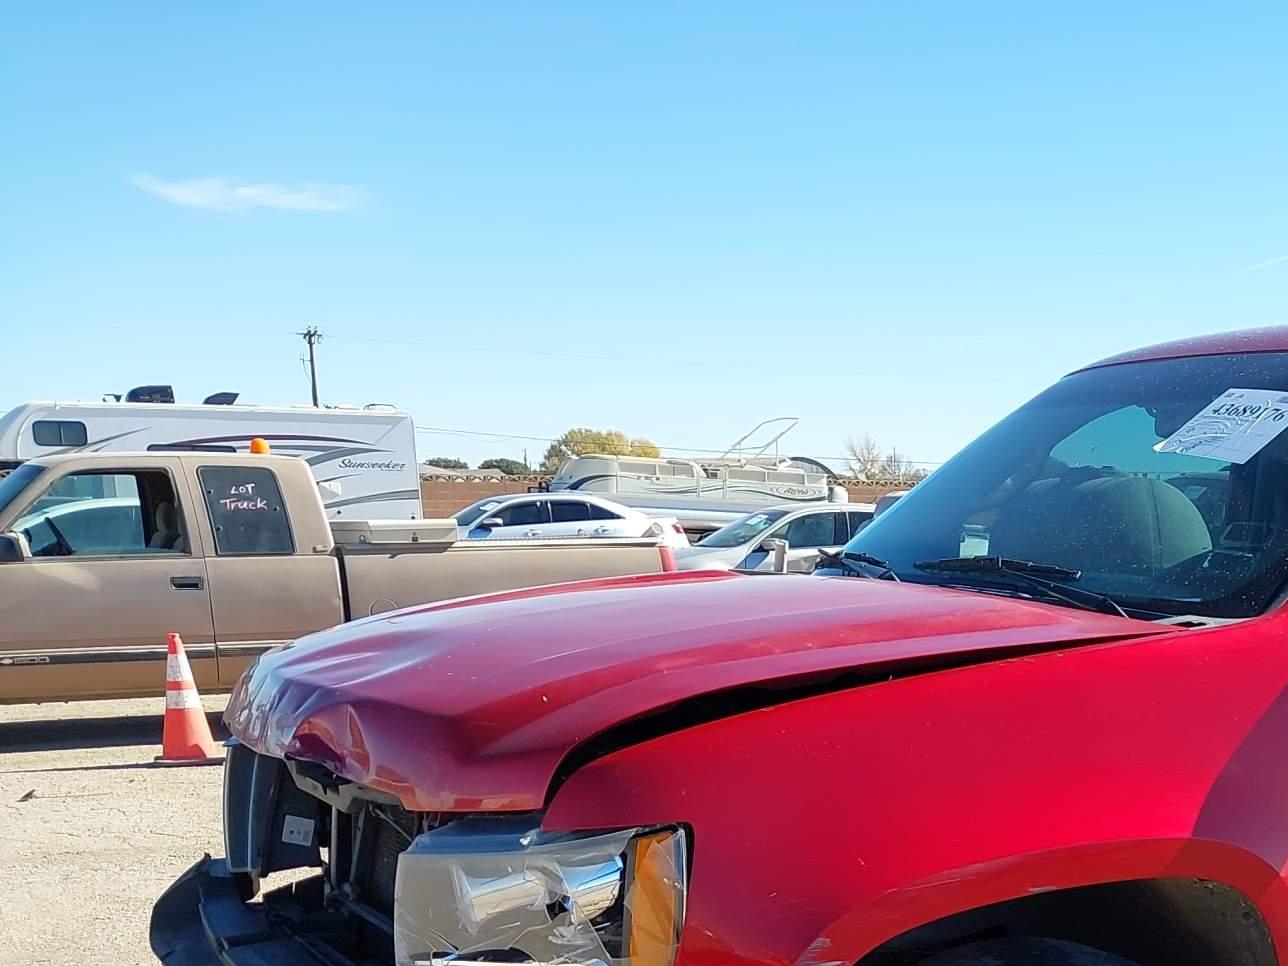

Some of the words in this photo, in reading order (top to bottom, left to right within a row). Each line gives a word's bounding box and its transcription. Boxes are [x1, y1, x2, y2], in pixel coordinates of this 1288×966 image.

[338, 459, 406, 470] Sunseeker
[230, 484, 255, 494] LOT
[219, 498, 267, 510] Truck
